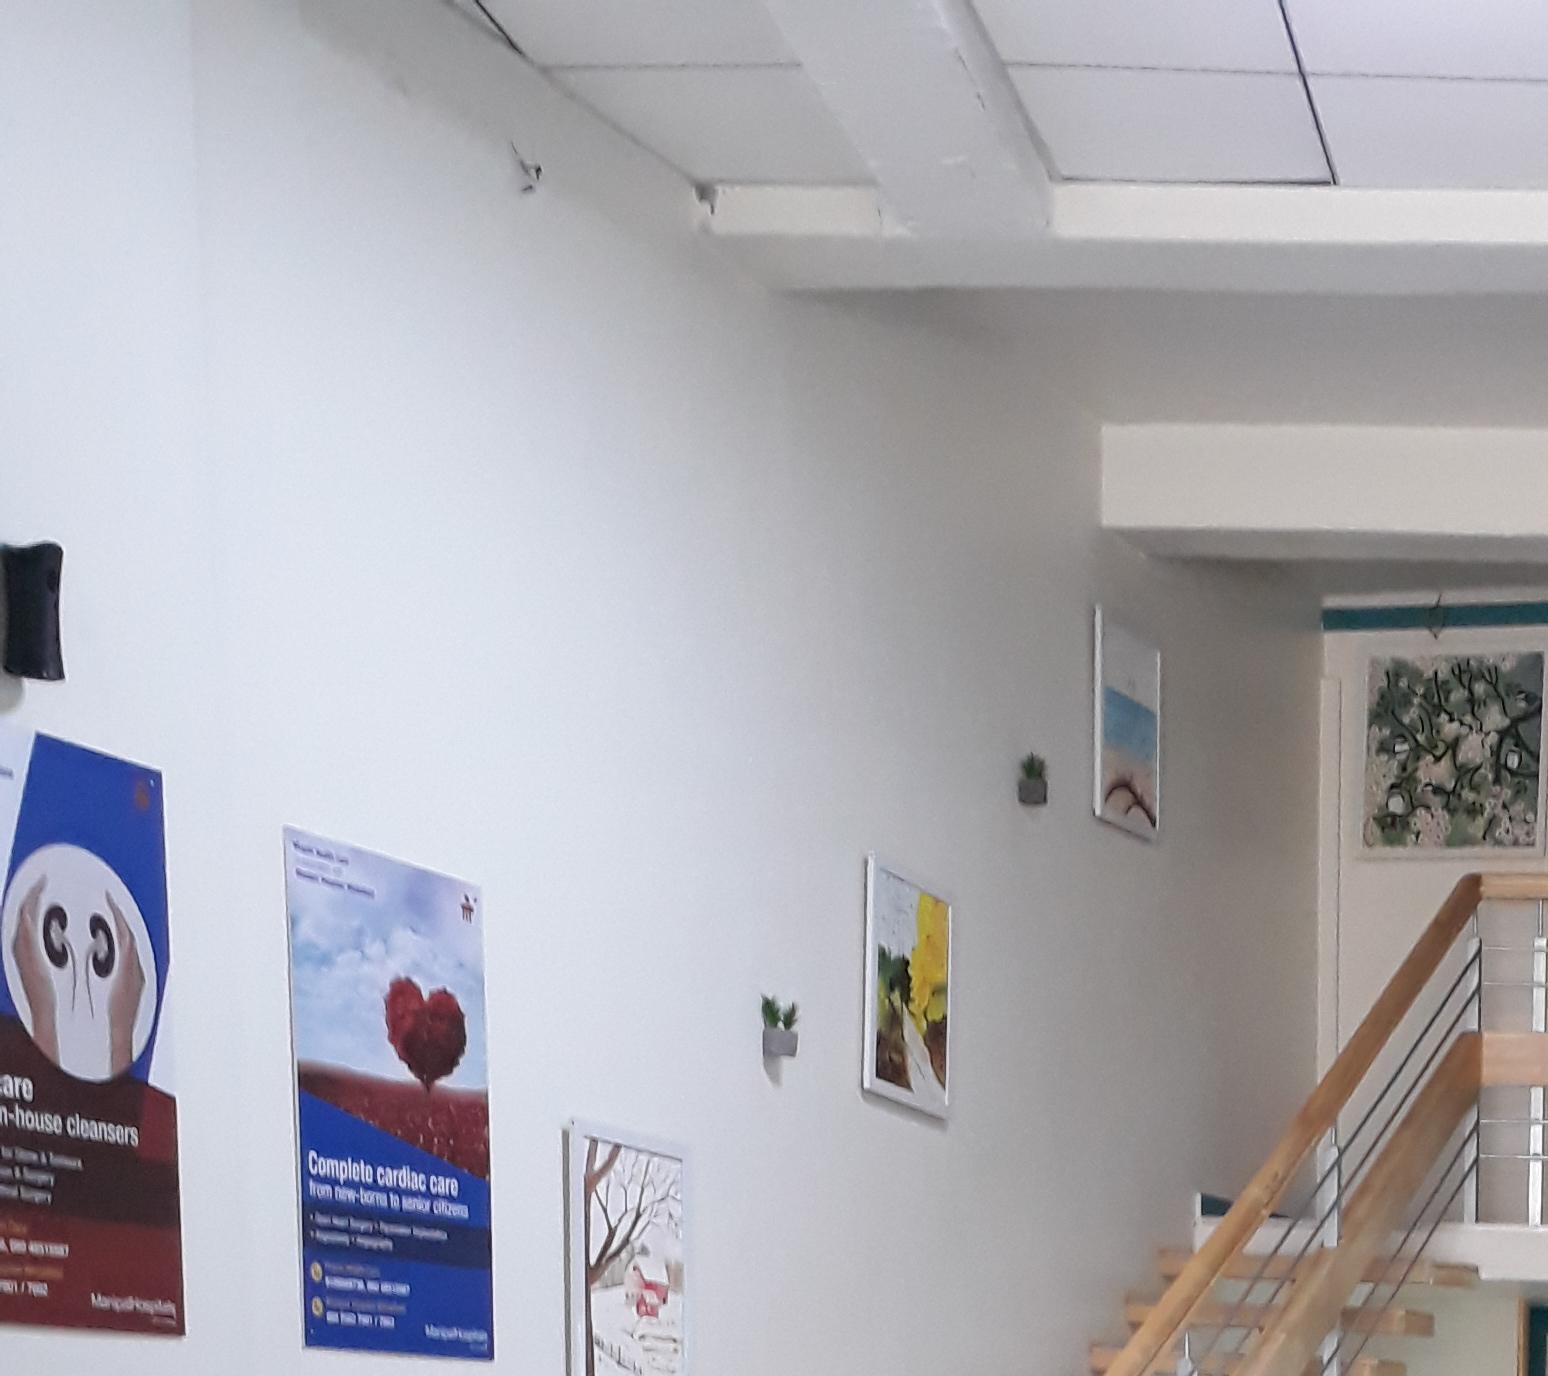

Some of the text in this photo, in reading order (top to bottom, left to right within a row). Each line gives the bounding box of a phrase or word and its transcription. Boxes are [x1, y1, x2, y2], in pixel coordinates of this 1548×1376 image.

[66, 1112, 139, 1147] cleansers
[308, 1149, 459, 1198] Complete cardiac care
[308, 1178, 333, 1200] from
[390, 1191, 400, 1209] to
